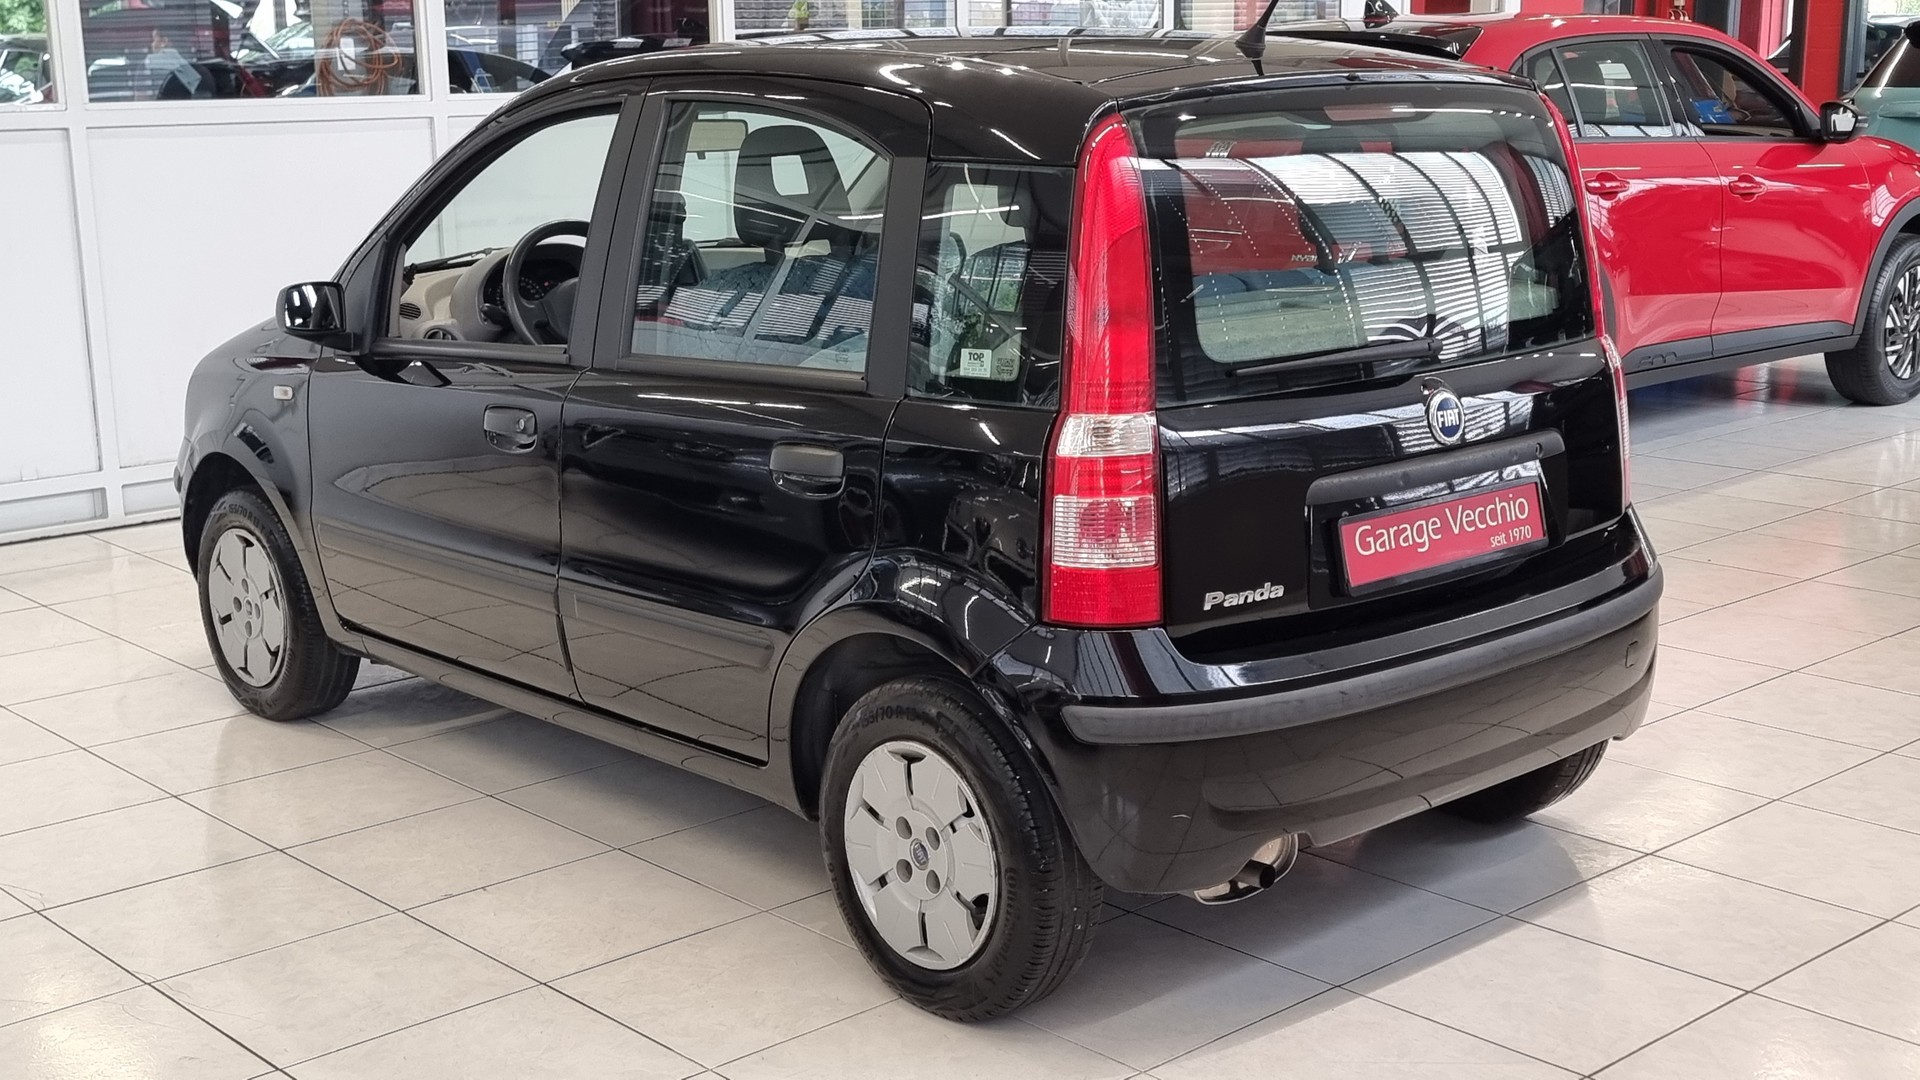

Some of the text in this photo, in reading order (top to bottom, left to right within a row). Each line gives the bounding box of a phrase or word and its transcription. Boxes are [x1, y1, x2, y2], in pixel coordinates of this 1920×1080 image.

[967, 351, 985, 361] TOP
[1437, 408, 1459, 428] FIAT
[1354, 493, 1529, 556] Garage Vecchio
[1490, 525, 1532, 548] seit 1970
[1203, 582, 1285, 611] Panda
